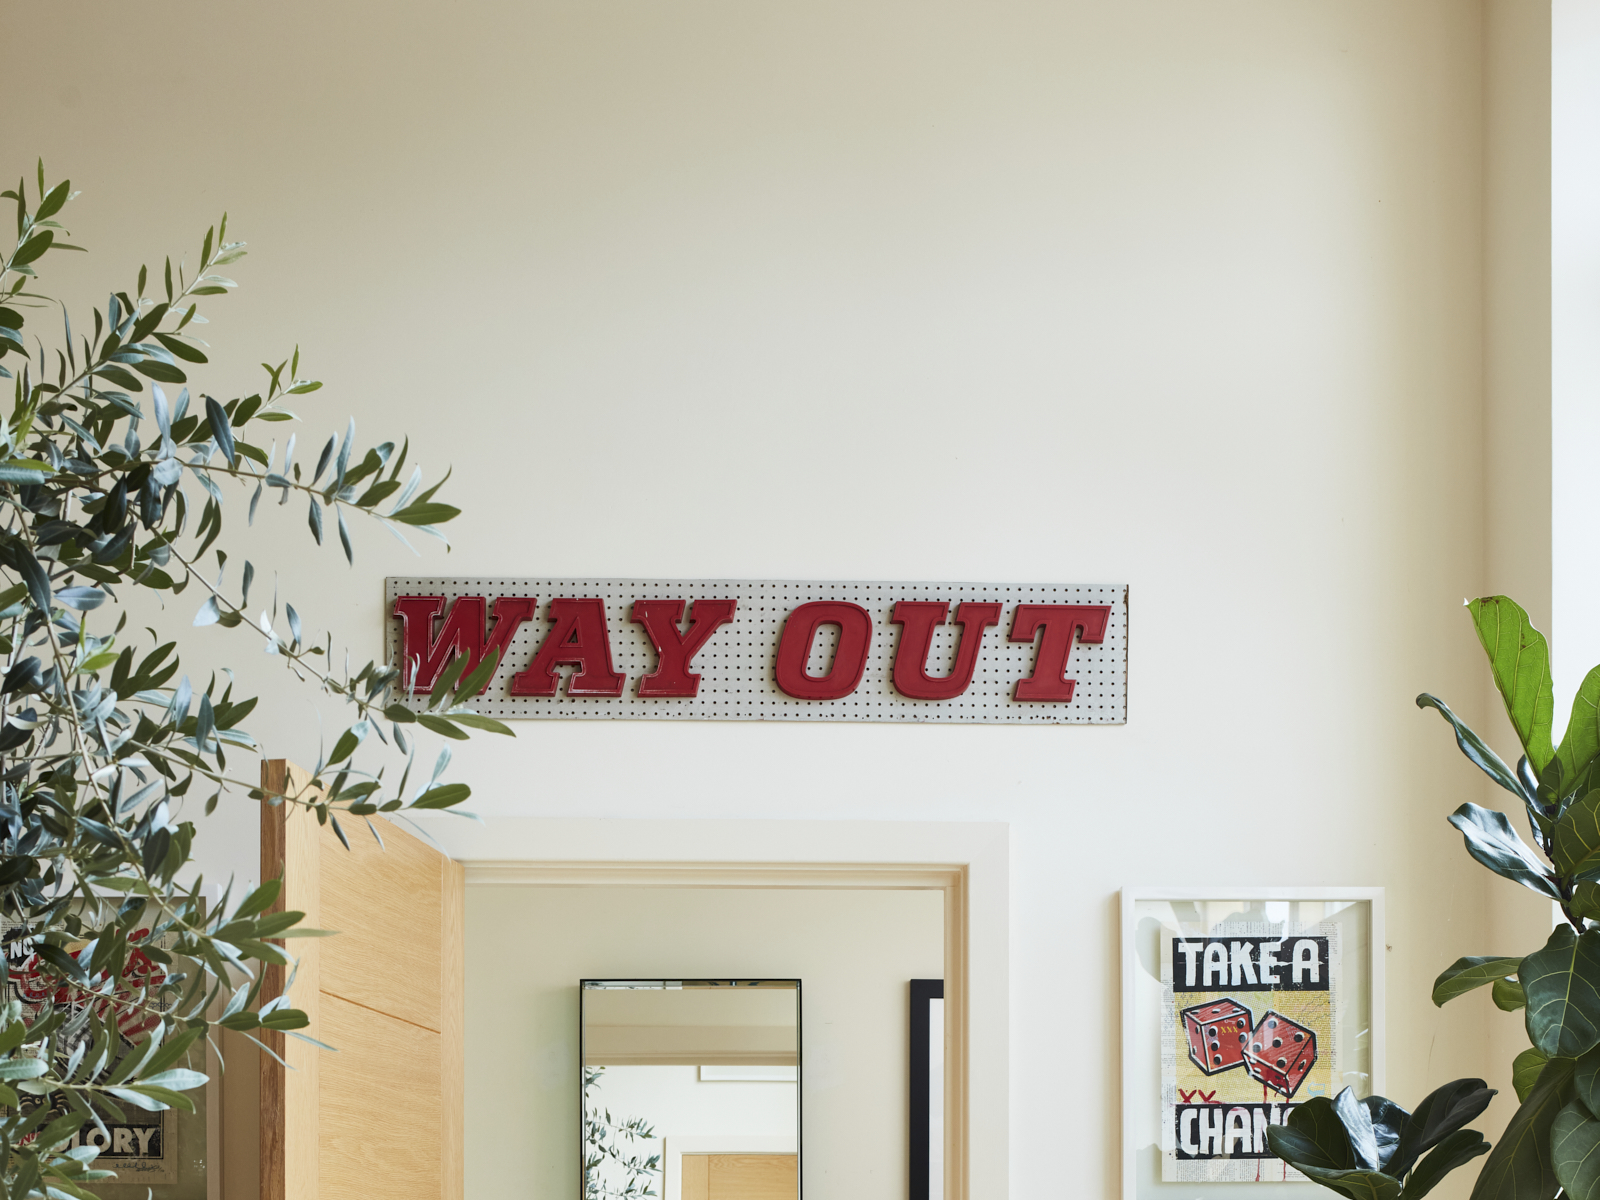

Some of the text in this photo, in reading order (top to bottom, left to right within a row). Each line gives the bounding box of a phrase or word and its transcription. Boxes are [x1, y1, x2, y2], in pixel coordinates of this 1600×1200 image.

[393, 596, 1112, 703] WAY OUT
[1178, 939, 1320, 986] TAKE A
[1180, 1107, 1294, 1155] CHAN
